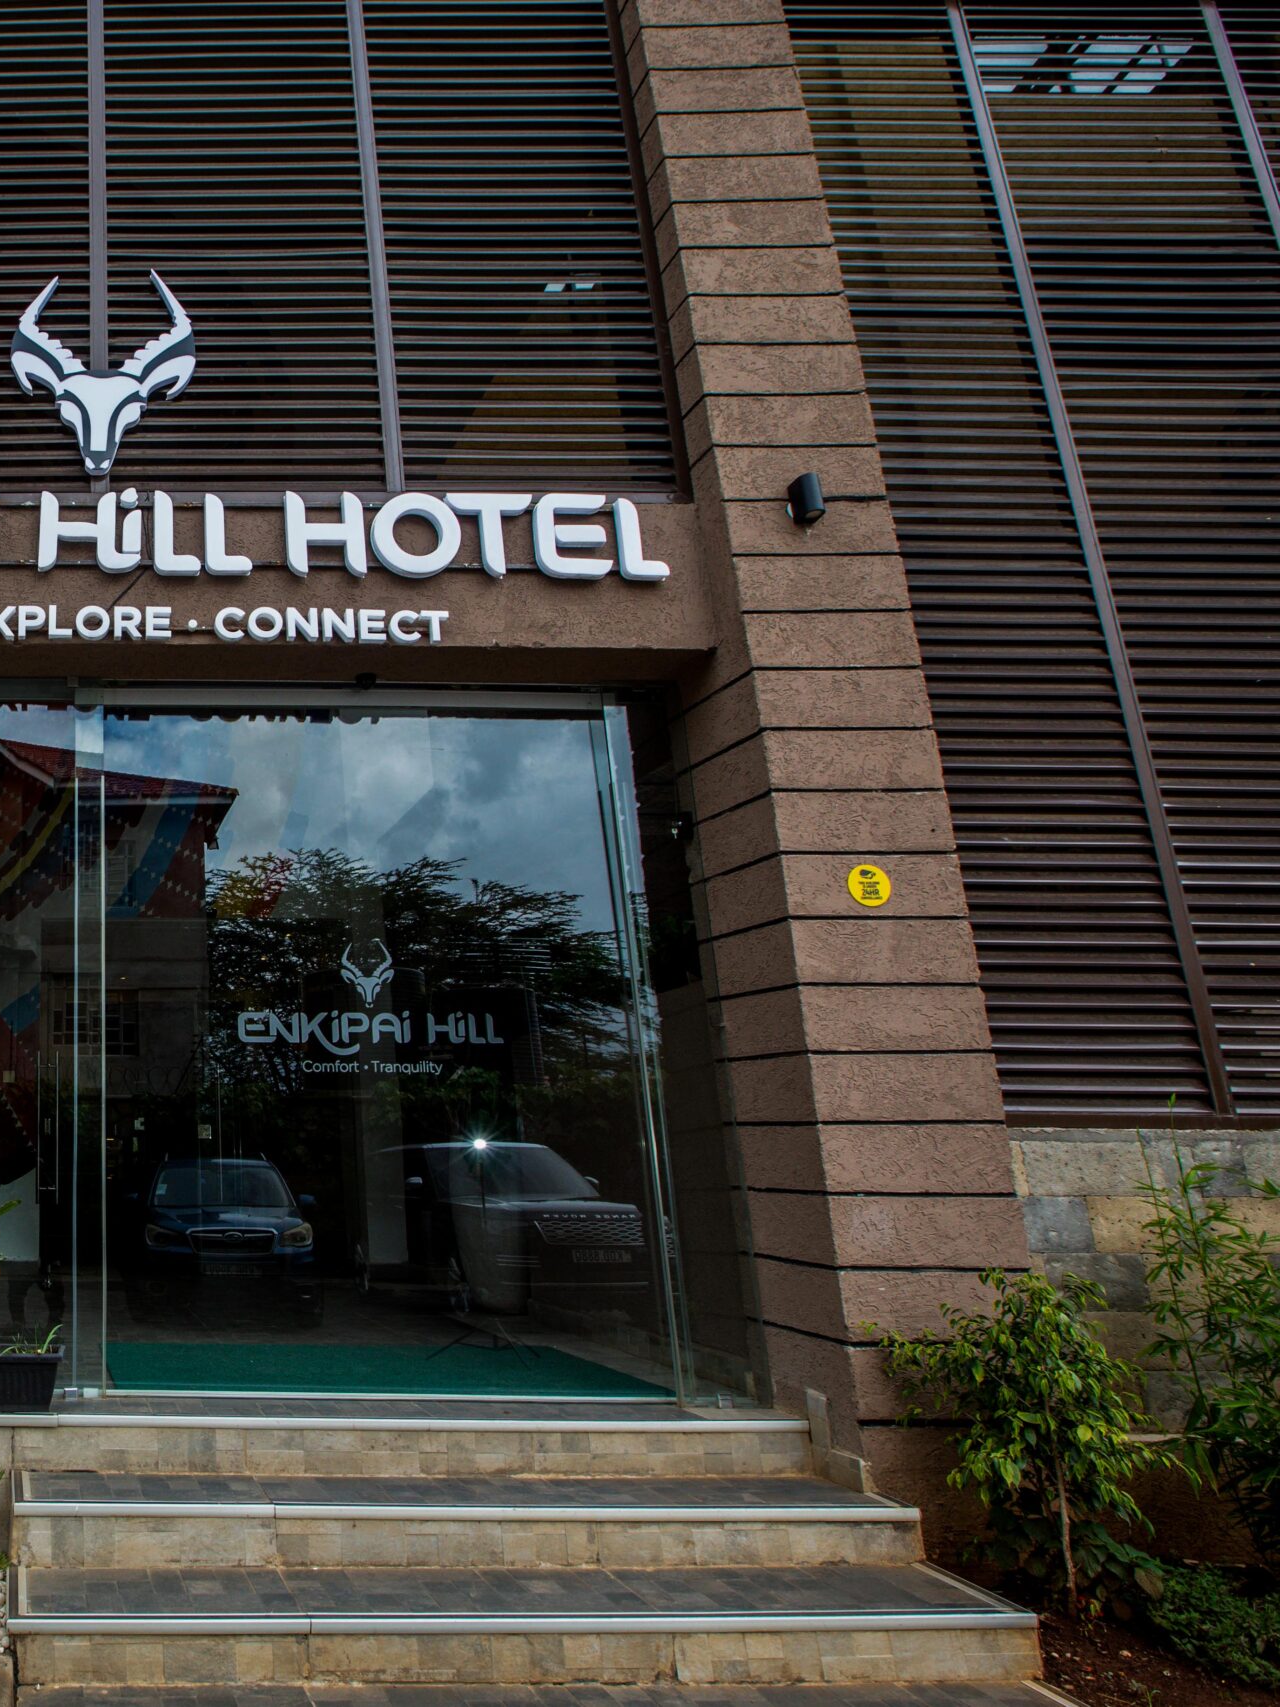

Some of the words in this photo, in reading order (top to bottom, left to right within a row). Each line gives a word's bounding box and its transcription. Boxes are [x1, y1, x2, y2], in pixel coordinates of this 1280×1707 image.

[283, 489, 671, 581] HOTEL
[213, 606, 450, 643] CONNECT
[302, 1060, 360, 1074] Comfort
[370, 1060, 444, 1076] Tranquility
